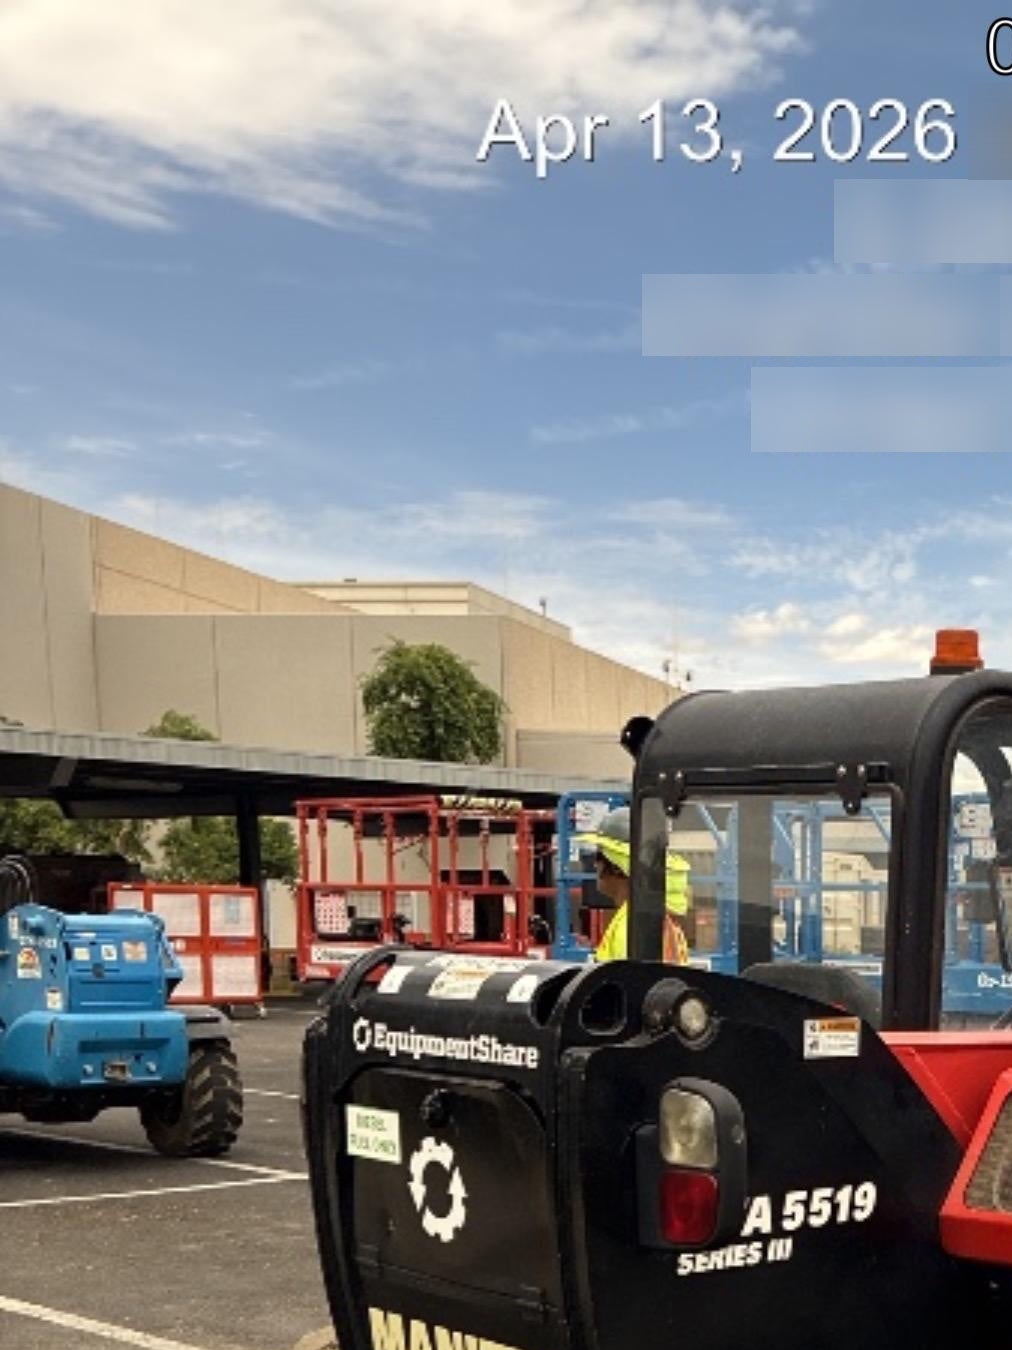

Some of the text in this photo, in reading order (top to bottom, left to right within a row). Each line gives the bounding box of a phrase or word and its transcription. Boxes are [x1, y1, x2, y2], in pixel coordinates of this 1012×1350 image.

[373, 1023, 539, 1069] EquipmentShare
[781, 1181, 878, 1232] 5519
[676, 1241, 763, 1277] SERIES
